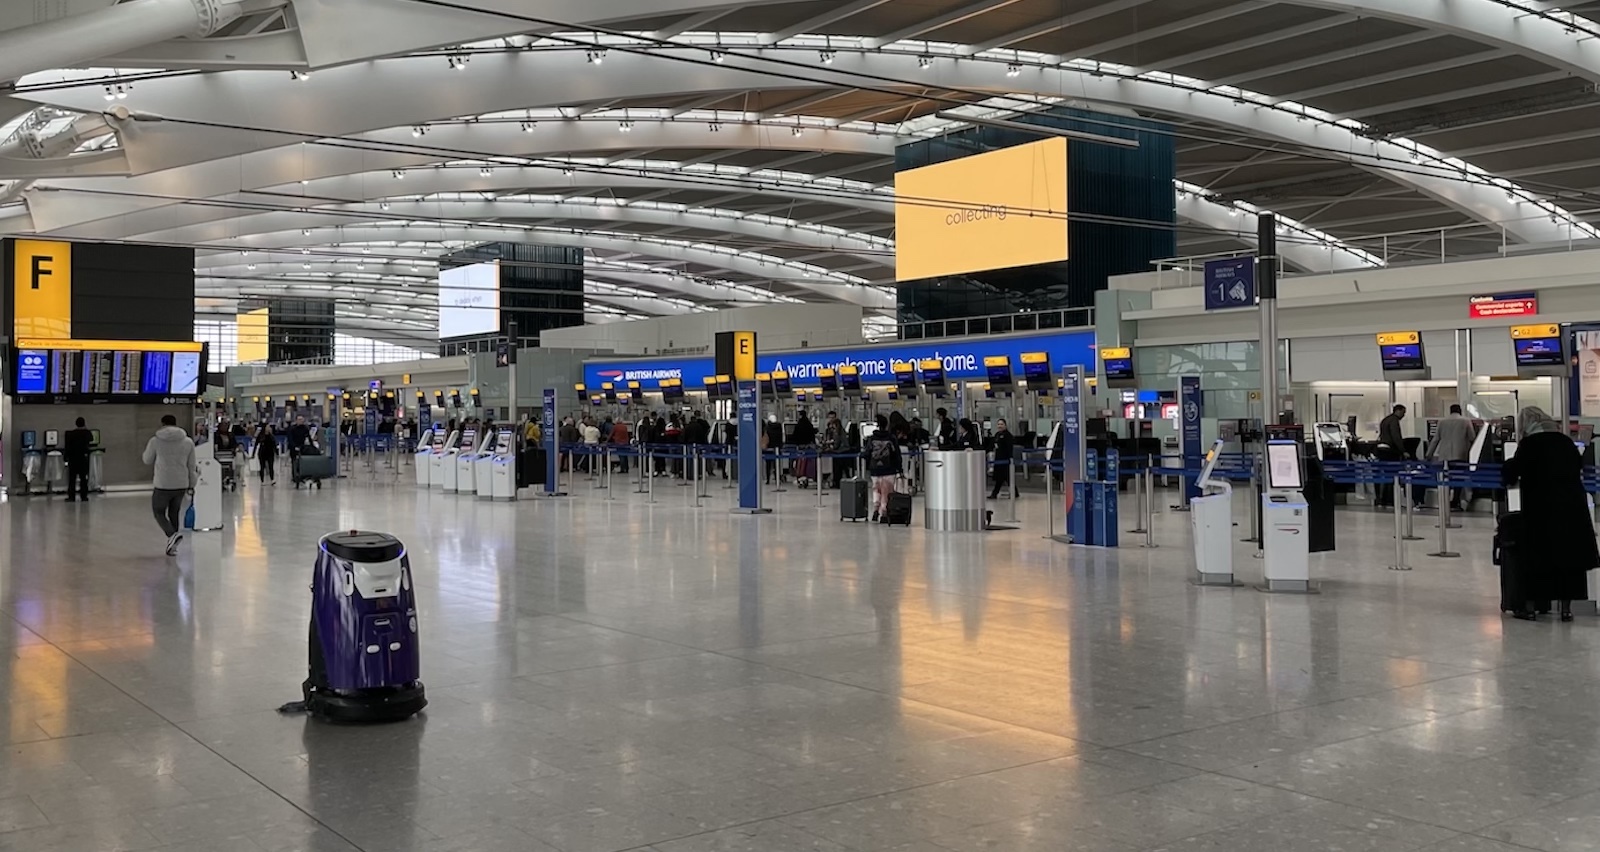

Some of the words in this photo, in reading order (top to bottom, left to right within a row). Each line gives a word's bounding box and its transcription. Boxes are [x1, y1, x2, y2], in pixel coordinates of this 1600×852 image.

[945, 203, 1006, 226] collecting
[32, 255, 53, 289] F
[1219, 282, 1225, 301] 1
[740, 338, 749, 355] E
[625, 370, 652, 380] BRITISH
[652, 369, 682, 379] AIRWAYS
[774, 360, 785, 372] A
[787, 362, 824, 378] warm
